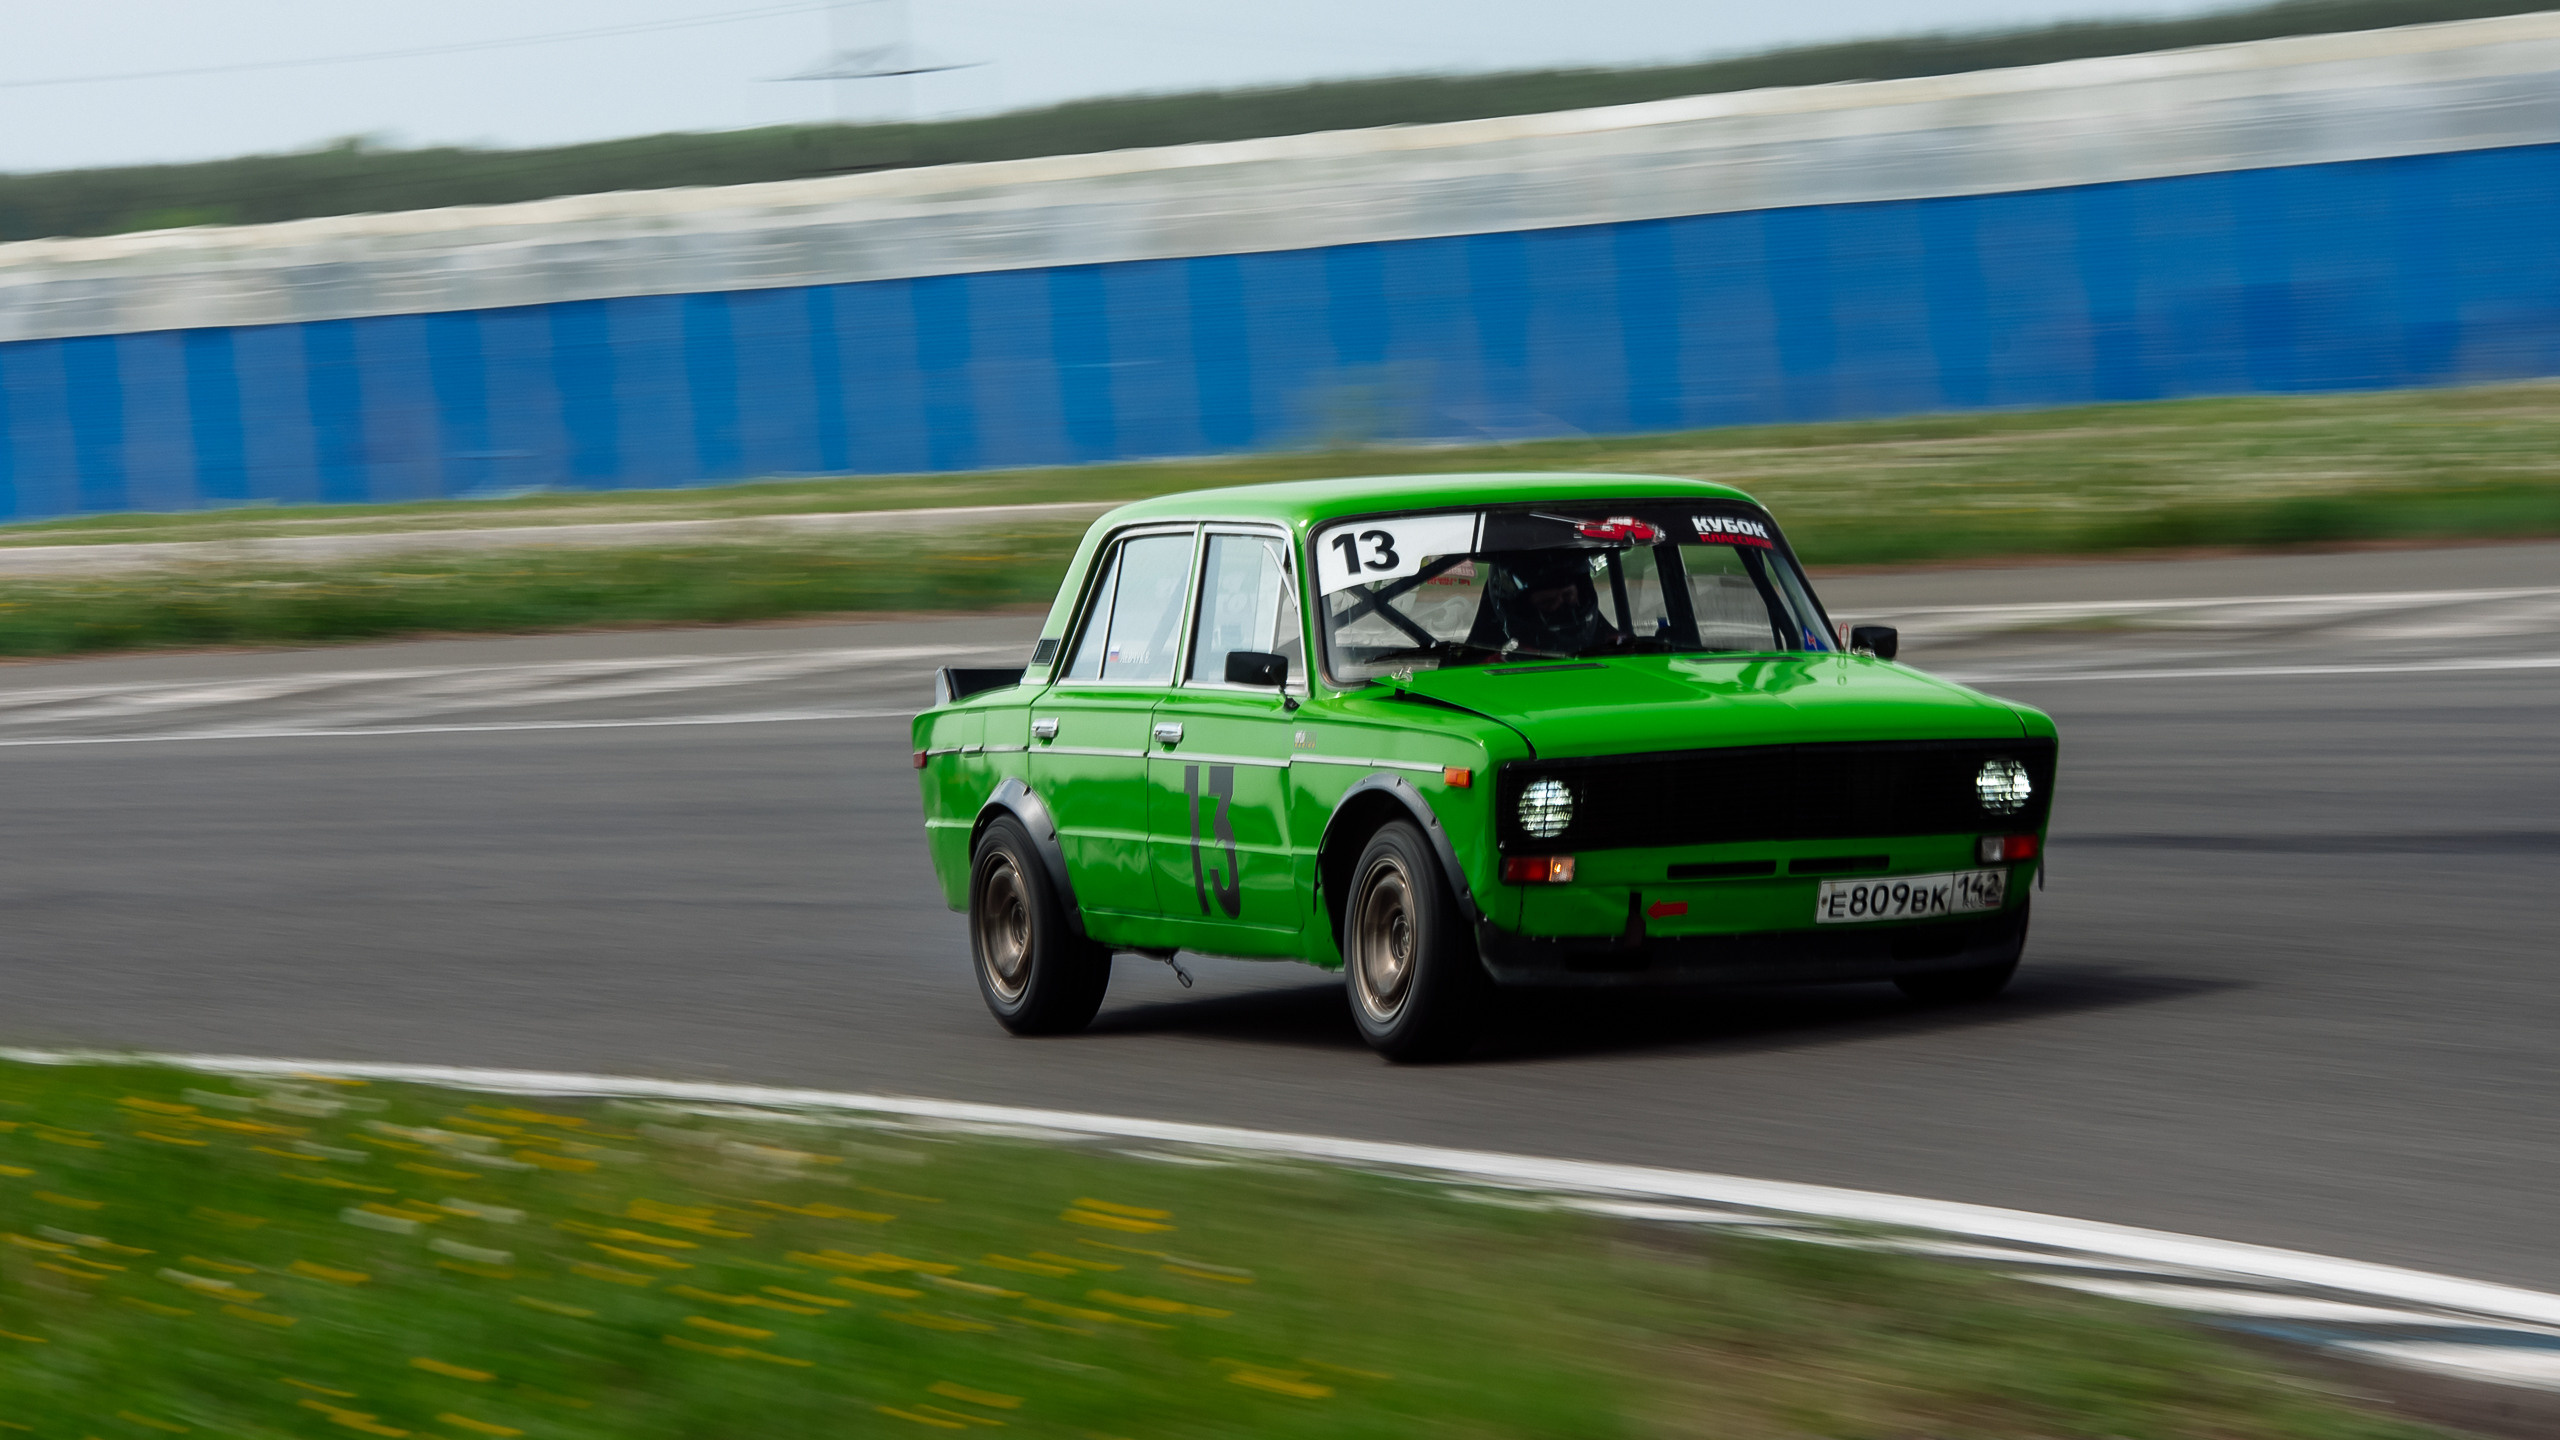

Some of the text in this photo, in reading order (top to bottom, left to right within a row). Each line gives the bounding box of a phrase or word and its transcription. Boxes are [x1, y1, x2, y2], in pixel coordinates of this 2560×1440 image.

[1692, 516, 1769, 539] КУБОК
[1332, 530, 1399, 575] 13
[1184, 765, 1240, 920] 13
[1828, 882, 1949, 918] Е809ВК
